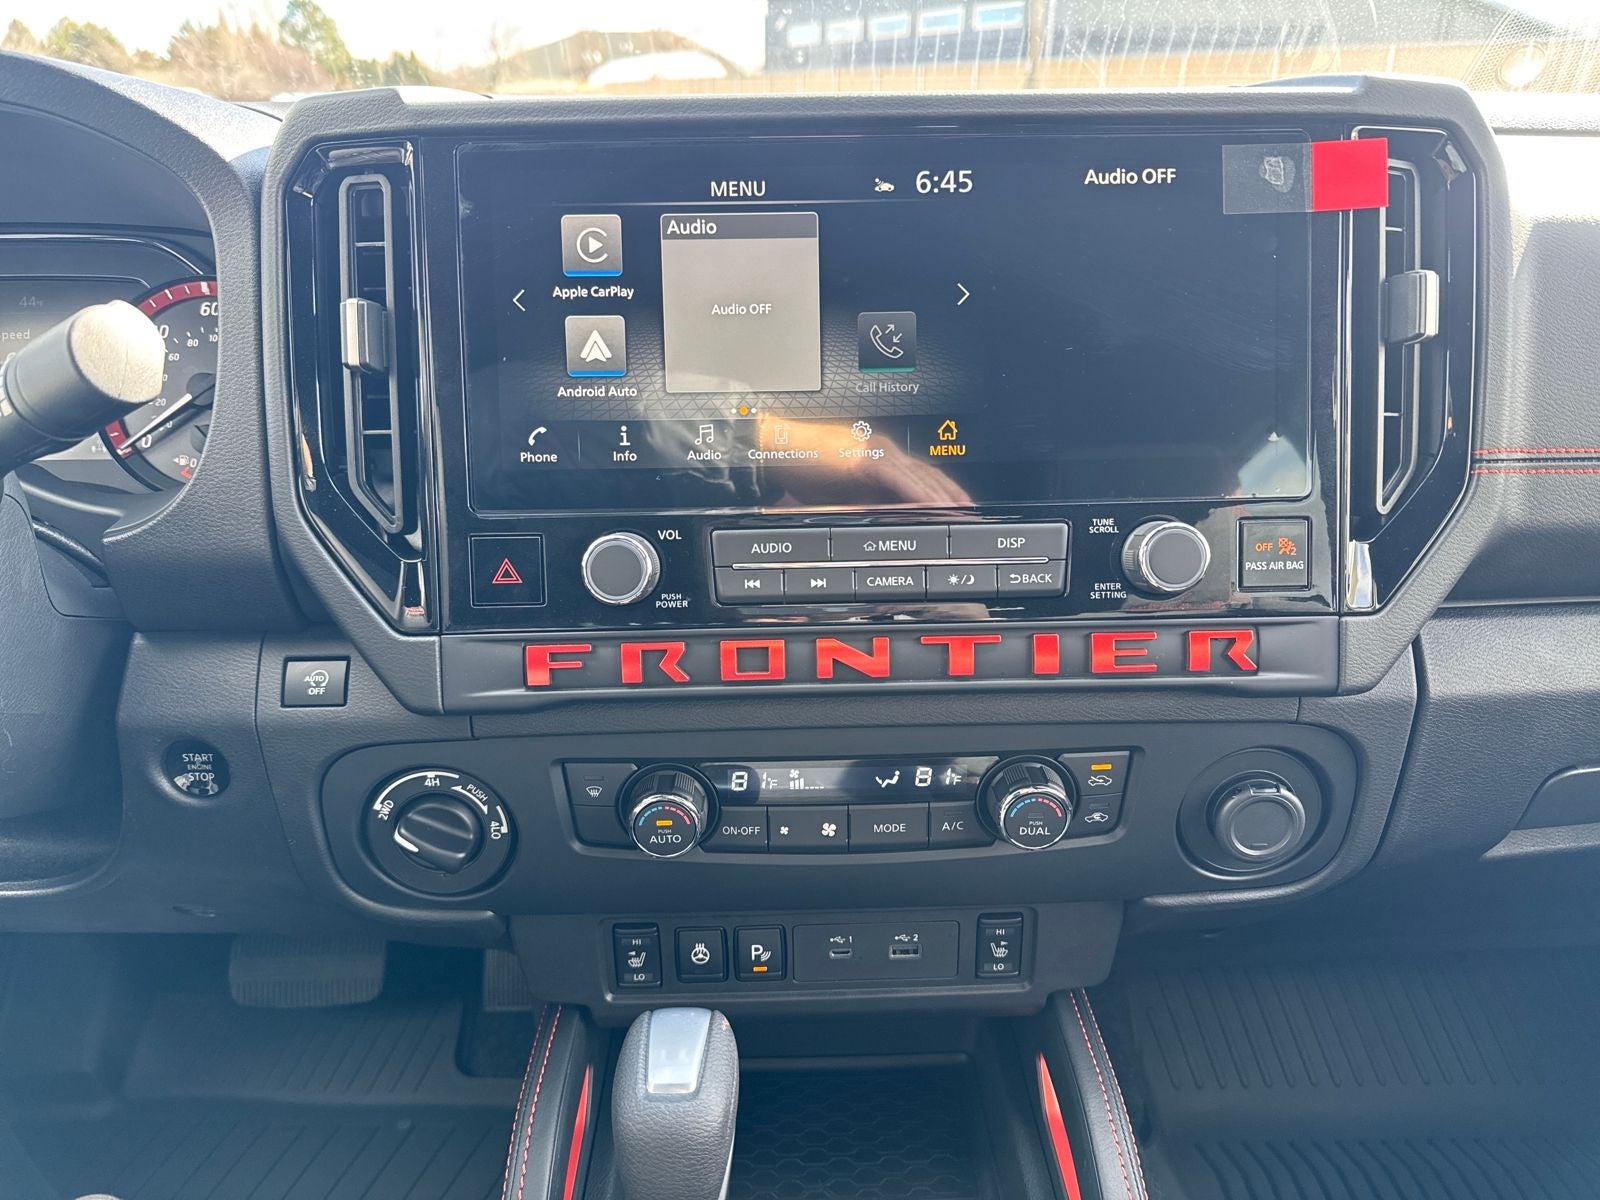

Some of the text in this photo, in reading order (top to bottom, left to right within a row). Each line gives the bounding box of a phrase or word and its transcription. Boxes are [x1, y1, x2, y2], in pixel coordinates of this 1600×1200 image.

[915, 169, 974, 194] 6:45
[1083, 167, 1177, 186] Audio OFF
[710, 180, 767, 197] MENU
[666, 219, 718, 236] Audio
[552, 285, 635, 300] Apple CarPlay
[200, 301, 218, 317] 60
[711, 303, 773, 316] Audio OFF
[0, 328, 31, 344] peed
[187, 338, 199, 348] 80
[168, 353, 180, 362] 60
[557, 386, 638, 398] Android Auto
[856, 380, 920, 396] Call History
[155, 398, 167, 407] 20
[141, 434, 152, 448] 0
[687, 450, 722, 461] Audio
[748, 449, 818, 460] Connections
[839, 448, 885, 461] Settings
[929, 445, 966, 456] MENU
[520, 452, 558, 463] Phone
[613, 451, 638, 463] Info
[189, 458, 198, 468] 0
[1092, 518, 1115, 526] TUNE
[657, 530, 682, 540] VOL
[1088, 526, 1120, 534] SCROLL
[751, 542, 793, 554] AUDIO
[878, 540, 917, 551] MENU
[997, 537, 1026, 549] DISP
[1255, 543, 1273, 552] OFF
[1245, 561, 1304, 571] PASS AIR BAG
[866, 576, 914, 587] CAMERA
[1022, 573, 1053, 584] BACK
[1094, 582, 1121, 591] ENTER
[661, 592, 682, 600] PUSH
[1090, 590, 1127, 600] SETTING
[655, 600, 688, 609] POWER
[524, 630, 1259, 687] FRONTIER
[304, 674, 325, 683] AUTO
[308, 687, 326, 696] OFF
[182, 753, 214, 763] START
[188, 772, 215, 783] STOP
[424, 777, 440, 787] 4H
[466, 783, 489, 803] PUSH
[377, 799, 395, 821] 2WD
[490, 820, 501, 840] 4LO
[873, 823, 907, 833] MODE
[941, 821, 965, 832] A/C
[1019, 826, 1051, 836] DUAL
[649, 834, 682, 844] AUTO
[912, 933, 919, 942] 2
[995, 928, 1005, 936] HI
[848, 935, 853, 944] 1
[992, 963, 1005, 971] LO
[633, 973, 646, 981] LO
